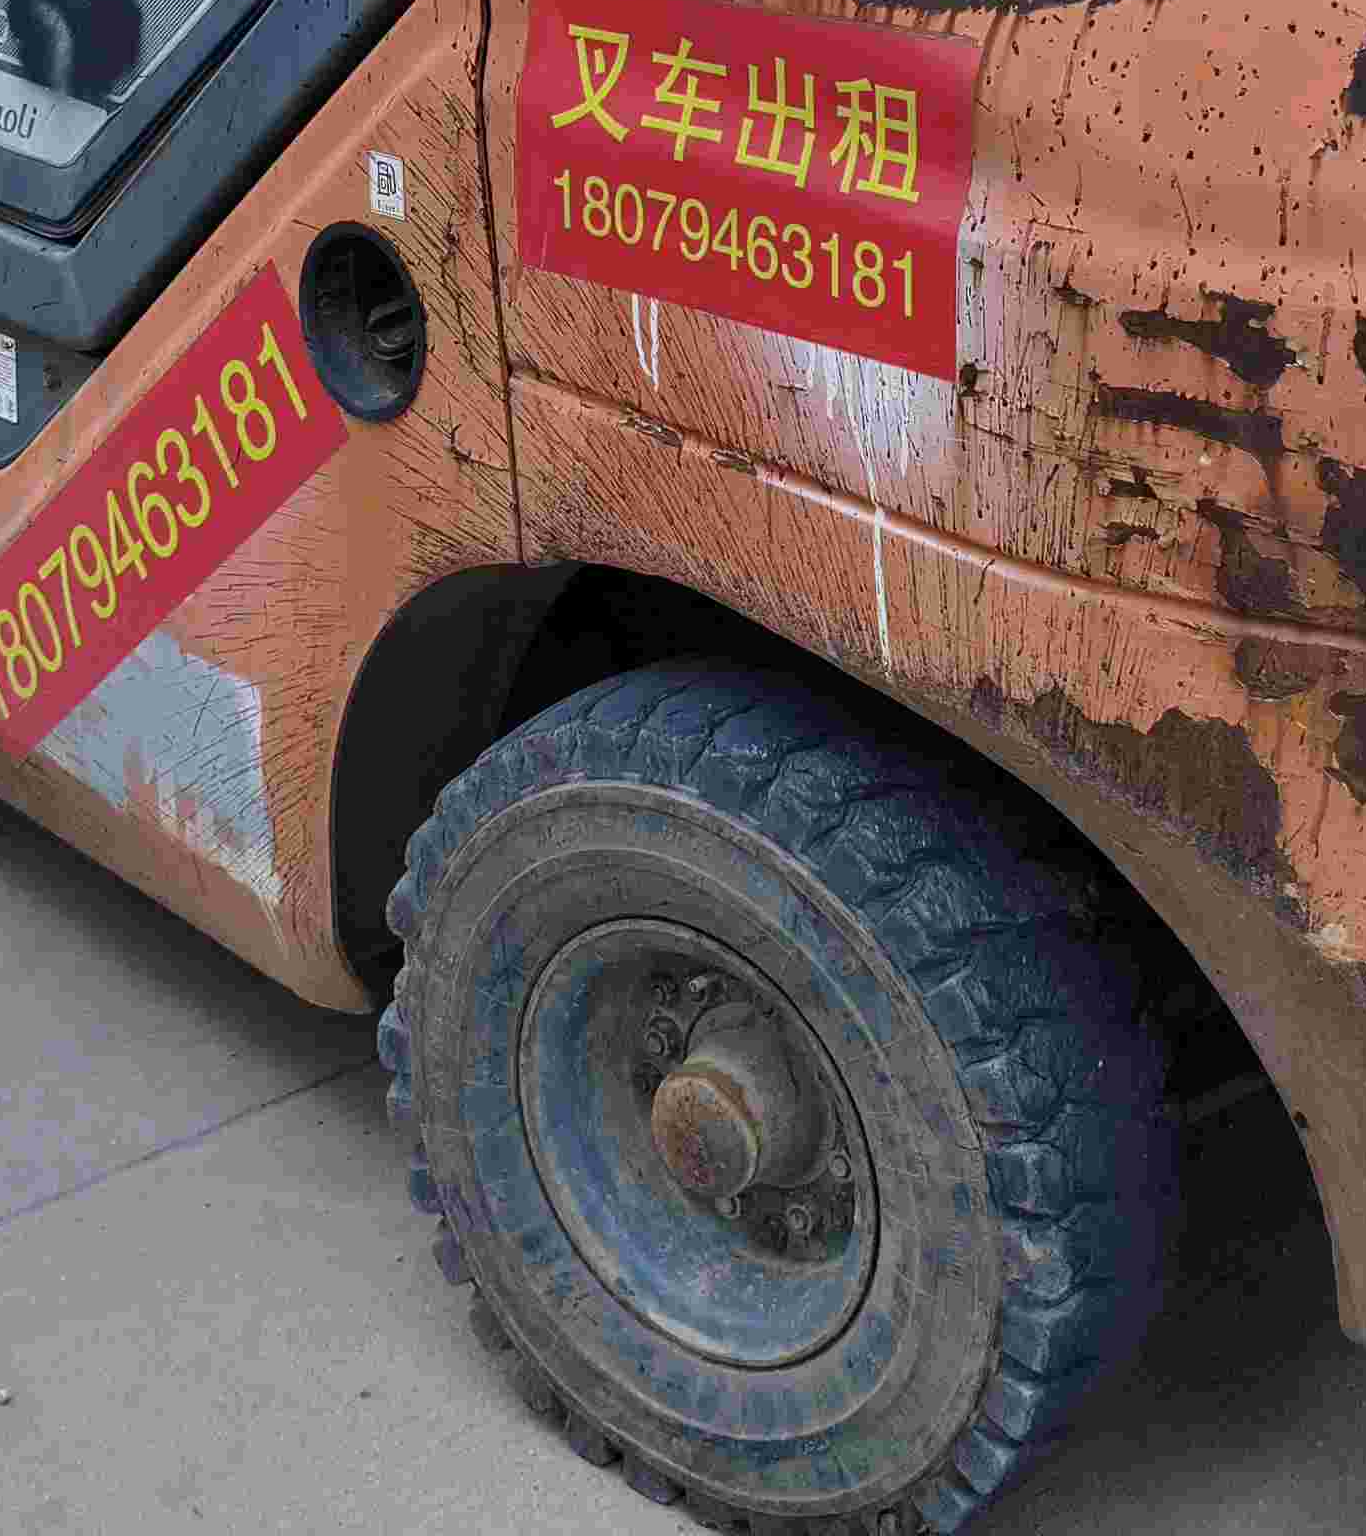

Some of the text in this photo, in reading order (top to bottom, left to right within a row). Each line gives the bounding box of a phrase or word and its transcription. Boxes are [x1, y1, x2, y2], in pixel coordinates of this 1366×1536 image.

[551, 22, 922, 205] 叉车出租
[553, 168, 916, 319] 18079463181
